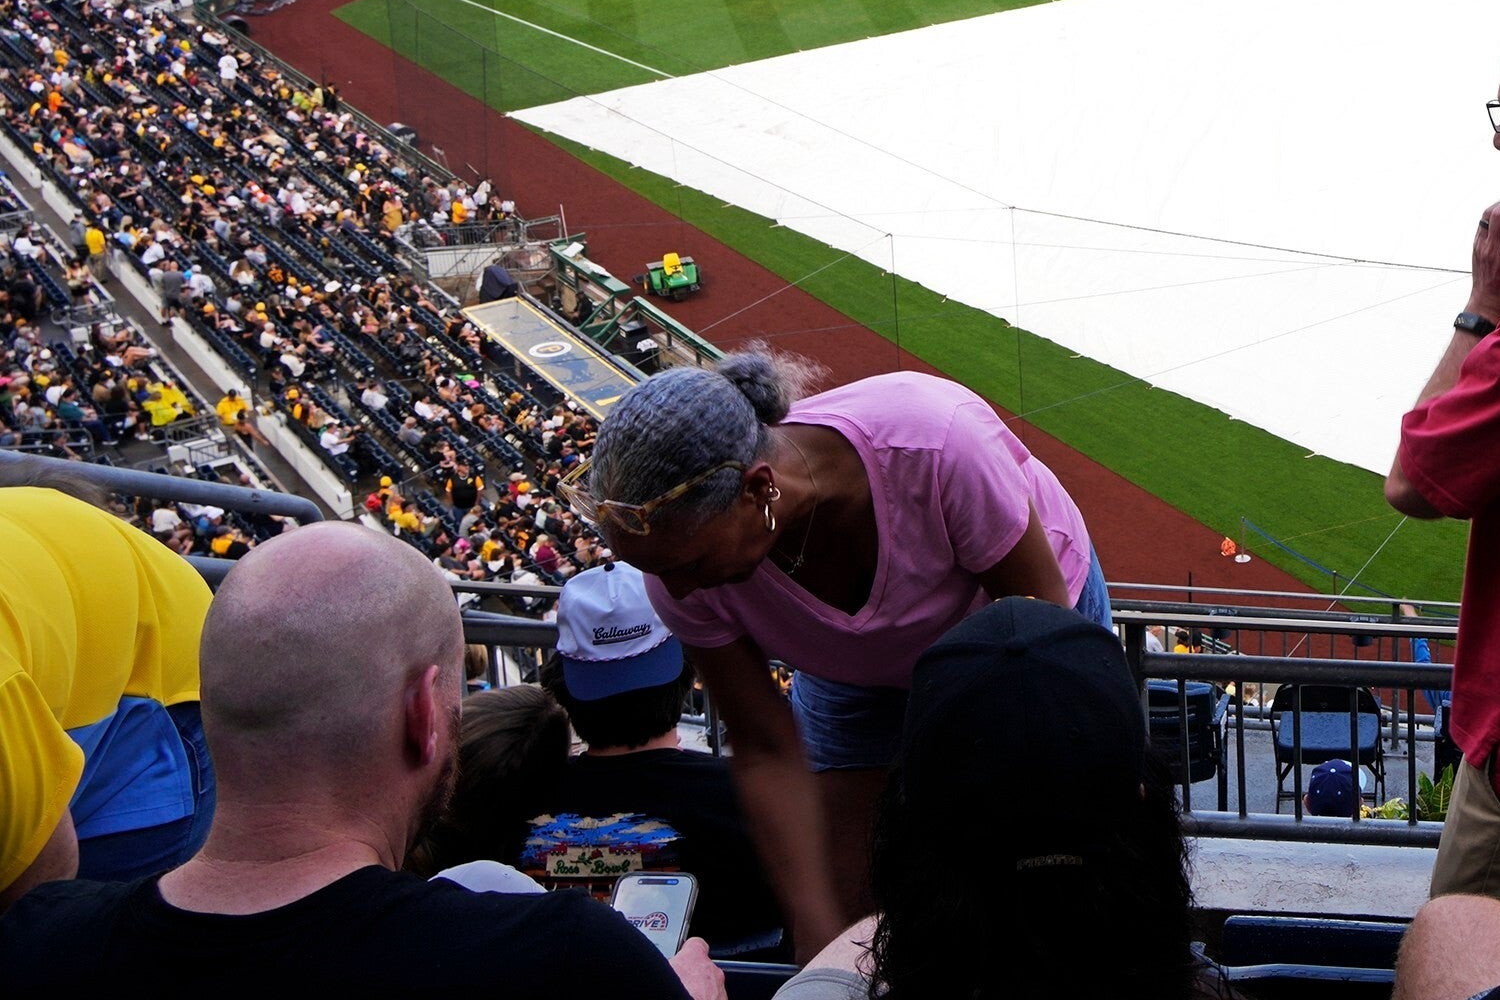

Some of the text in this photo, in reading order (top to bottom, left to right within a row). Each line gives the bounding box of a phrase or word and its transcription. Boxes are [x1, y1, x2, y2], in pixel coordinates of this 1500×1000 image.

[593, 622, 651, 640] Callaway
[554, 859, 630, 874] Rose Bowl
